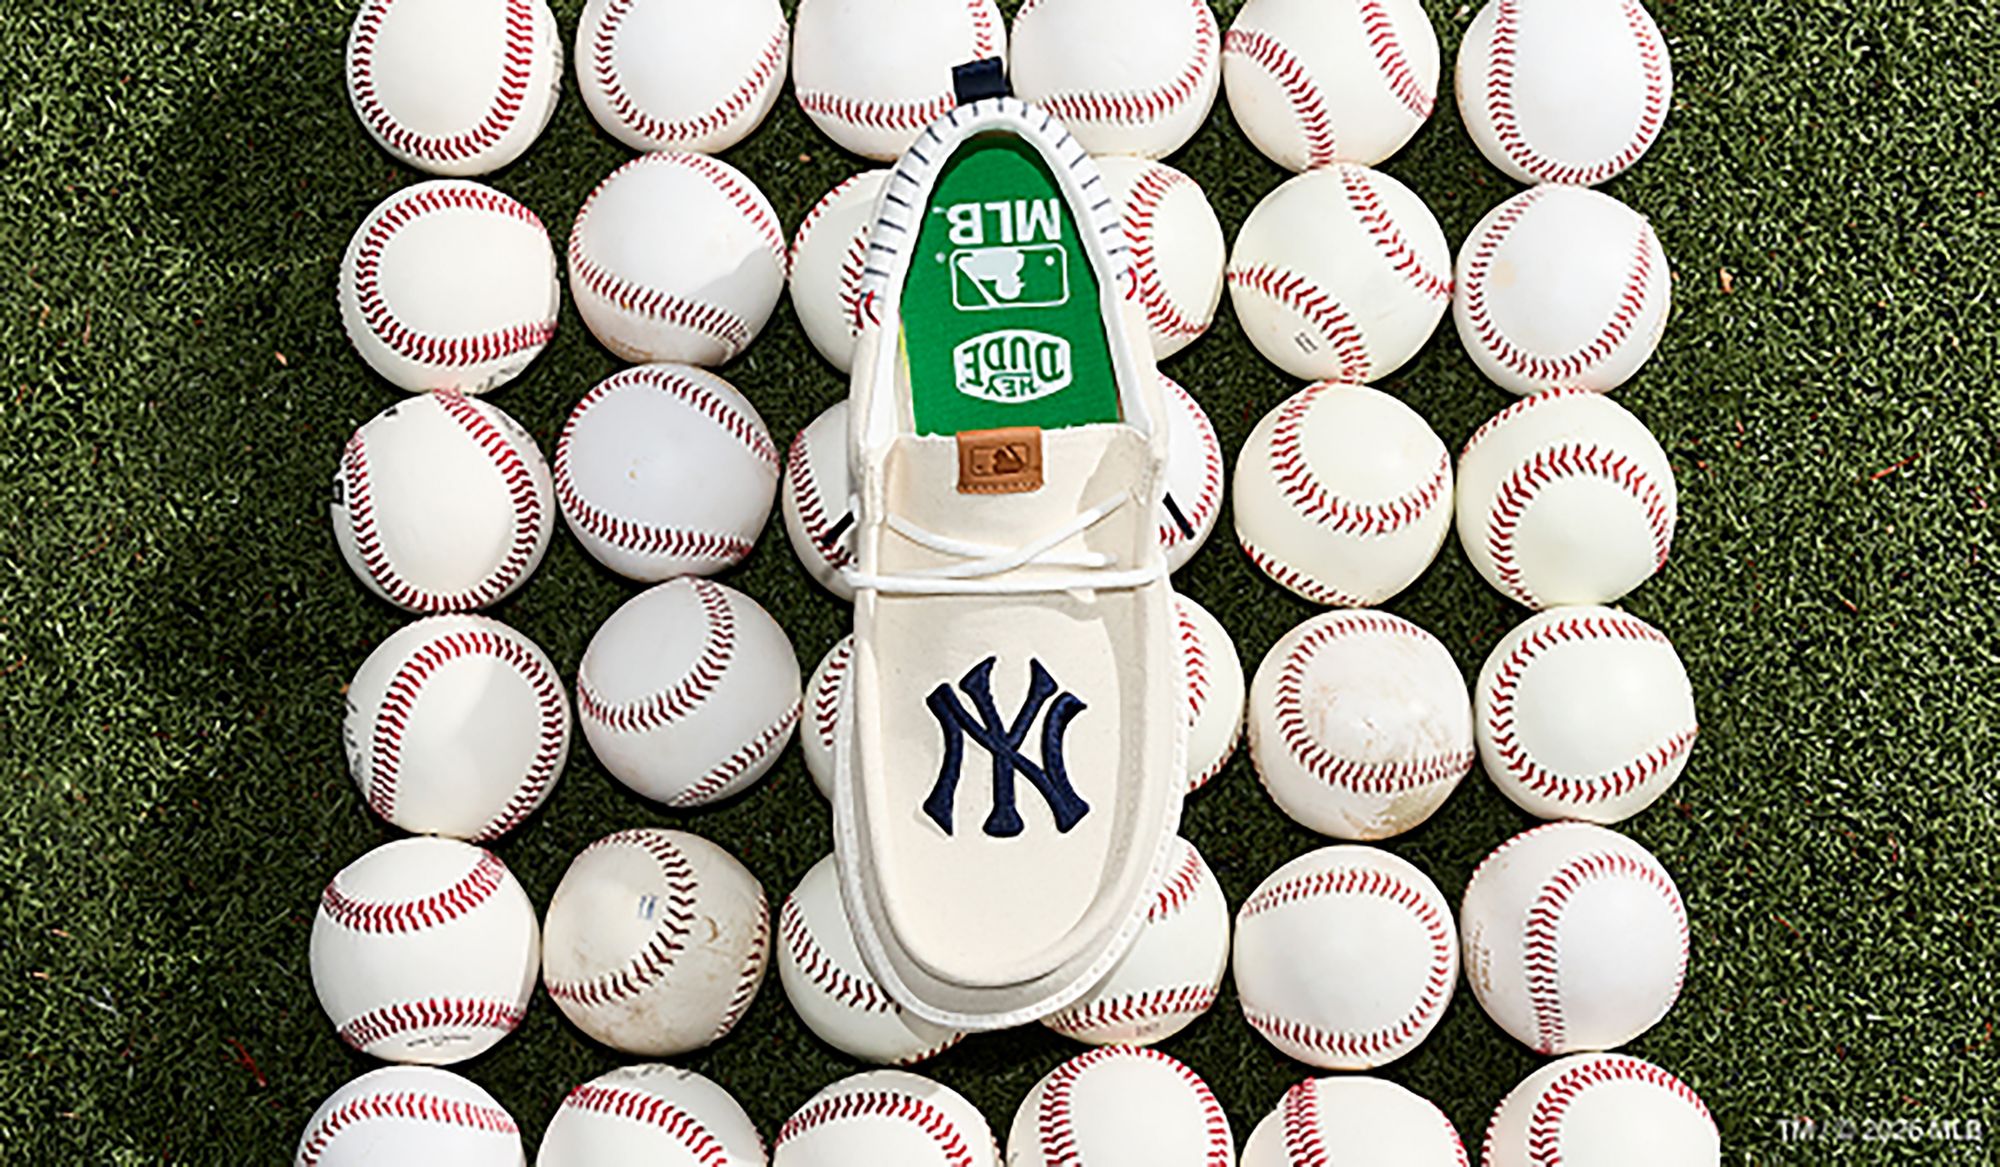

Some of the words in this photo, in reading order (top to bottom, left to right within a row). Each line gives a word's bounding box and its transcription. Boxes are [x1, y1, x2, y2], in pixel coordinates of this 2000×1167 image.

[946, 198, 1061, 244] MLB
[963, 336, 1065, 387] DUDE
[984, 377, 1037, 397] HEY
[923, 656, 1090, 838] NY
